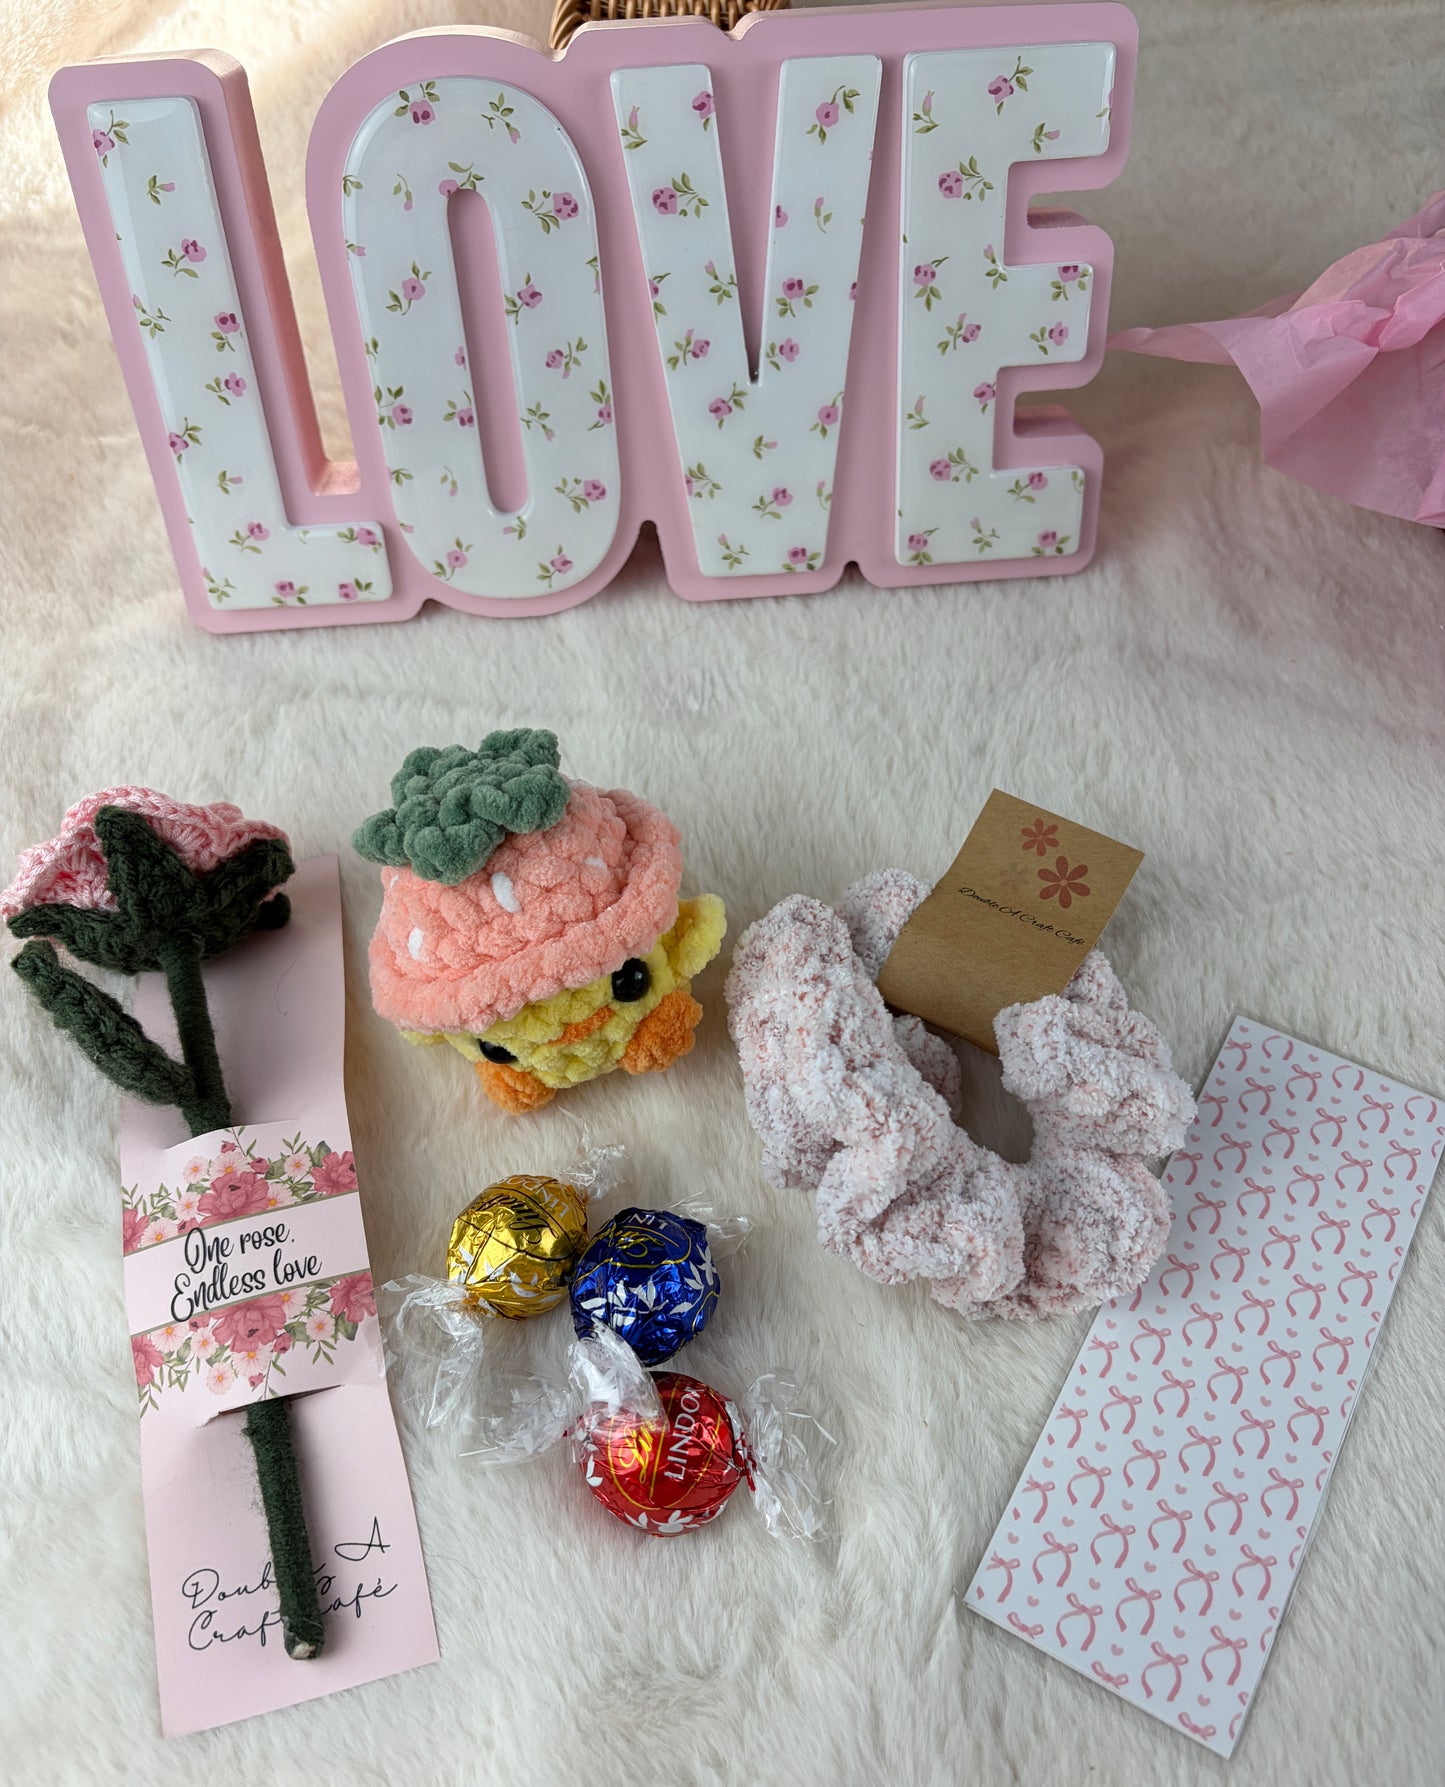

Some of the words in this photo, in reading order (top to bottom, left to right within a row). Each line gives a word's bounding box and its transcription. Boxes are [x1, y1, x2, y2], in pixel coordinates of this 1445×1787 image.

[84, 41, 1118, 610] LOVE
[958, 887, 999, 908] Double
[1018, 913, 1055, 933] Craft
[184, 1227, 235, 1274] One
[170, 1262, 266, 1323] Endless
[273, 1248, 323, 1285] love
[334, 1515, 391, 1562] A
